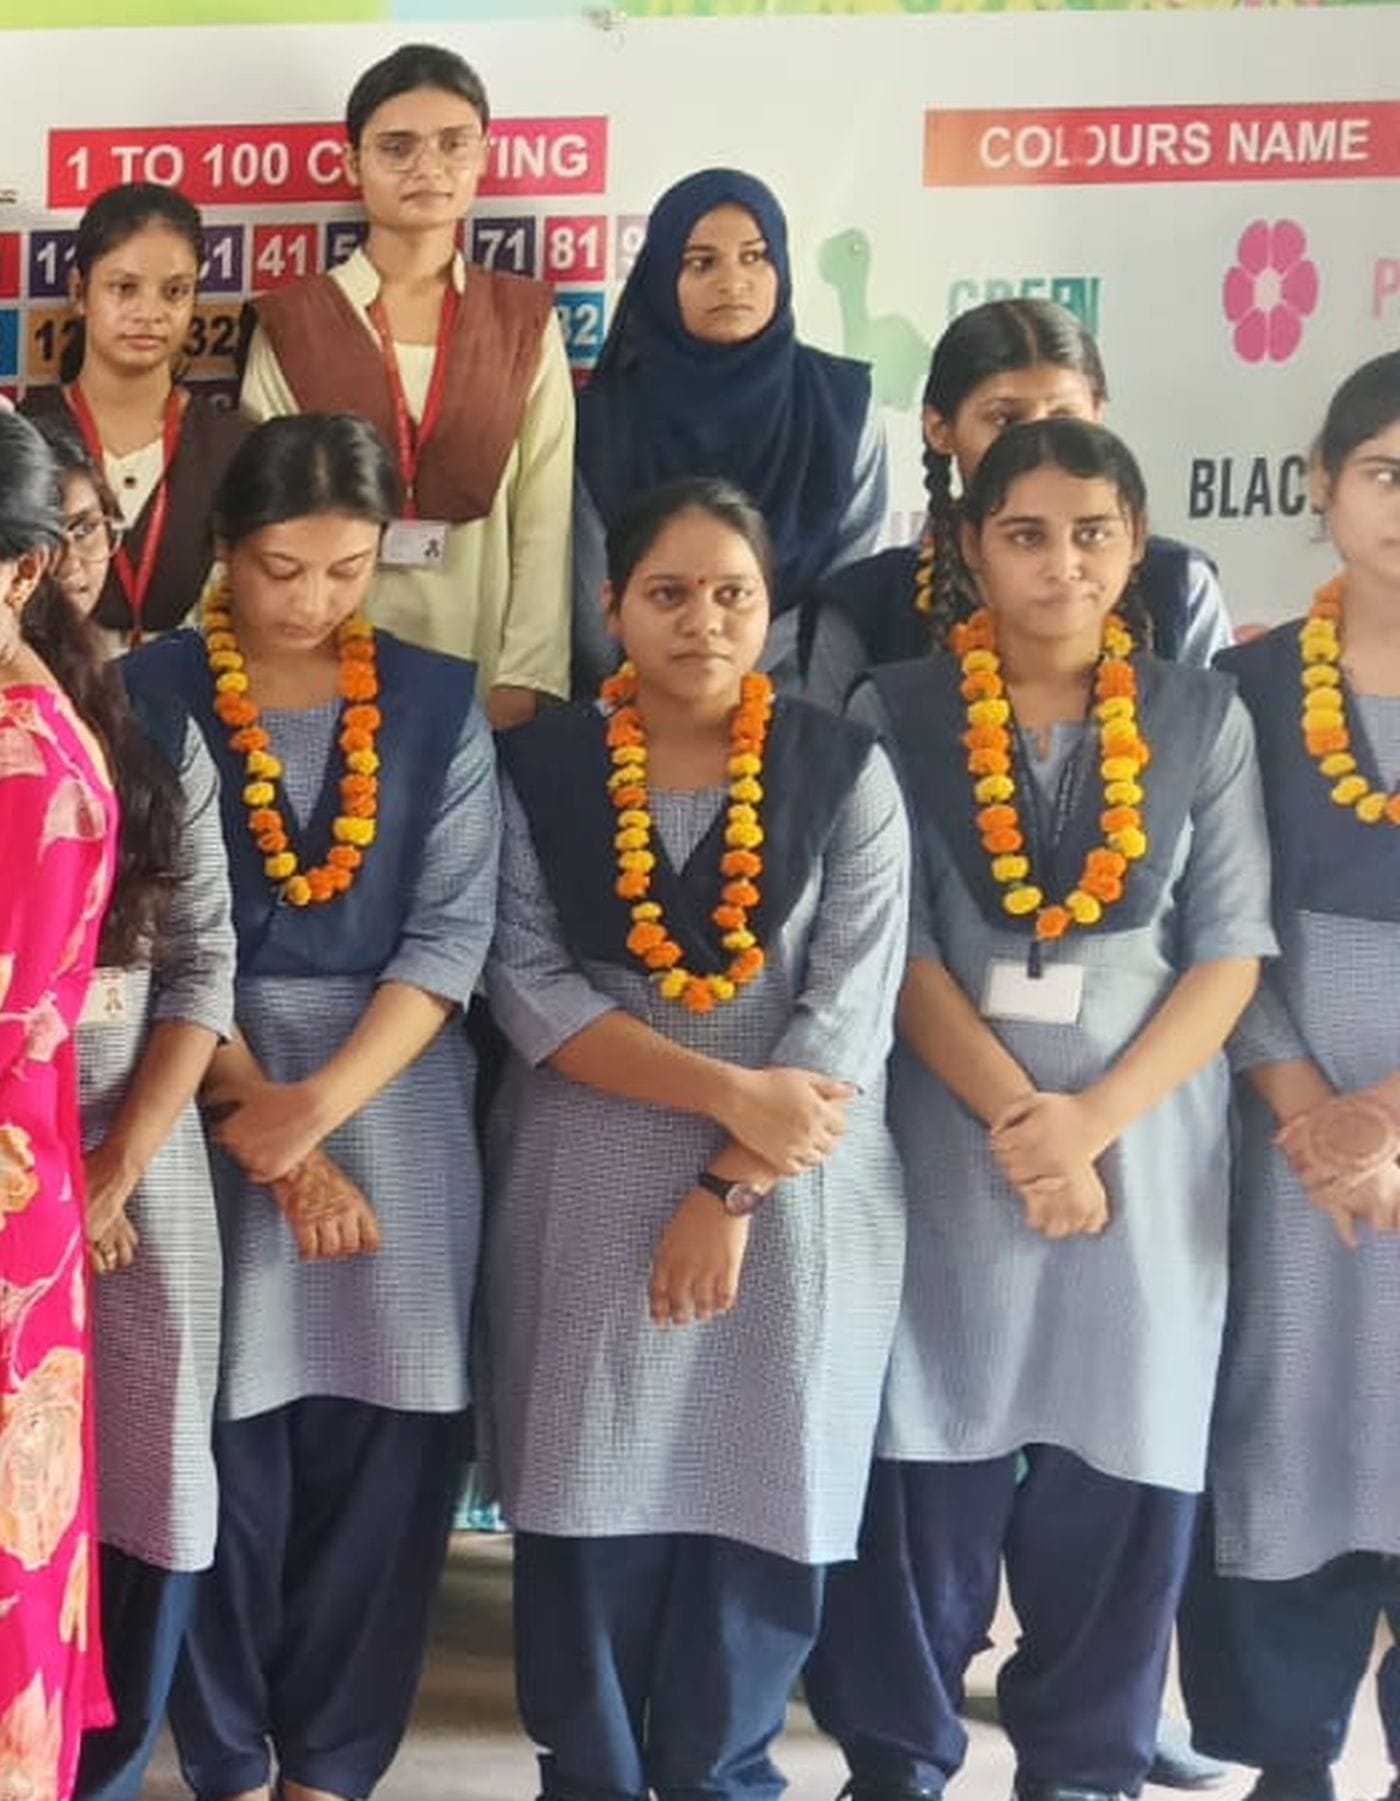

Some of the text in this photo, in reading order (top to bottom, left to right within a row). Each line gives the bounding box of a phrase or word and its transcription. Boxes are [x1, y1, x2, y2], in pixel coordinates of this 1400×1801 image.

[66, 134, 589, 191] 1 TO 100 CING
[1228, 119, 1371, 164] NAME
[36, 240, 76, 285] 1
[257, 234, 308, 277] 41
[477, 228, 527, 275] 71
[550, 225, 599, 270] 81
[1188, 454, 1308, 519] BLAC
